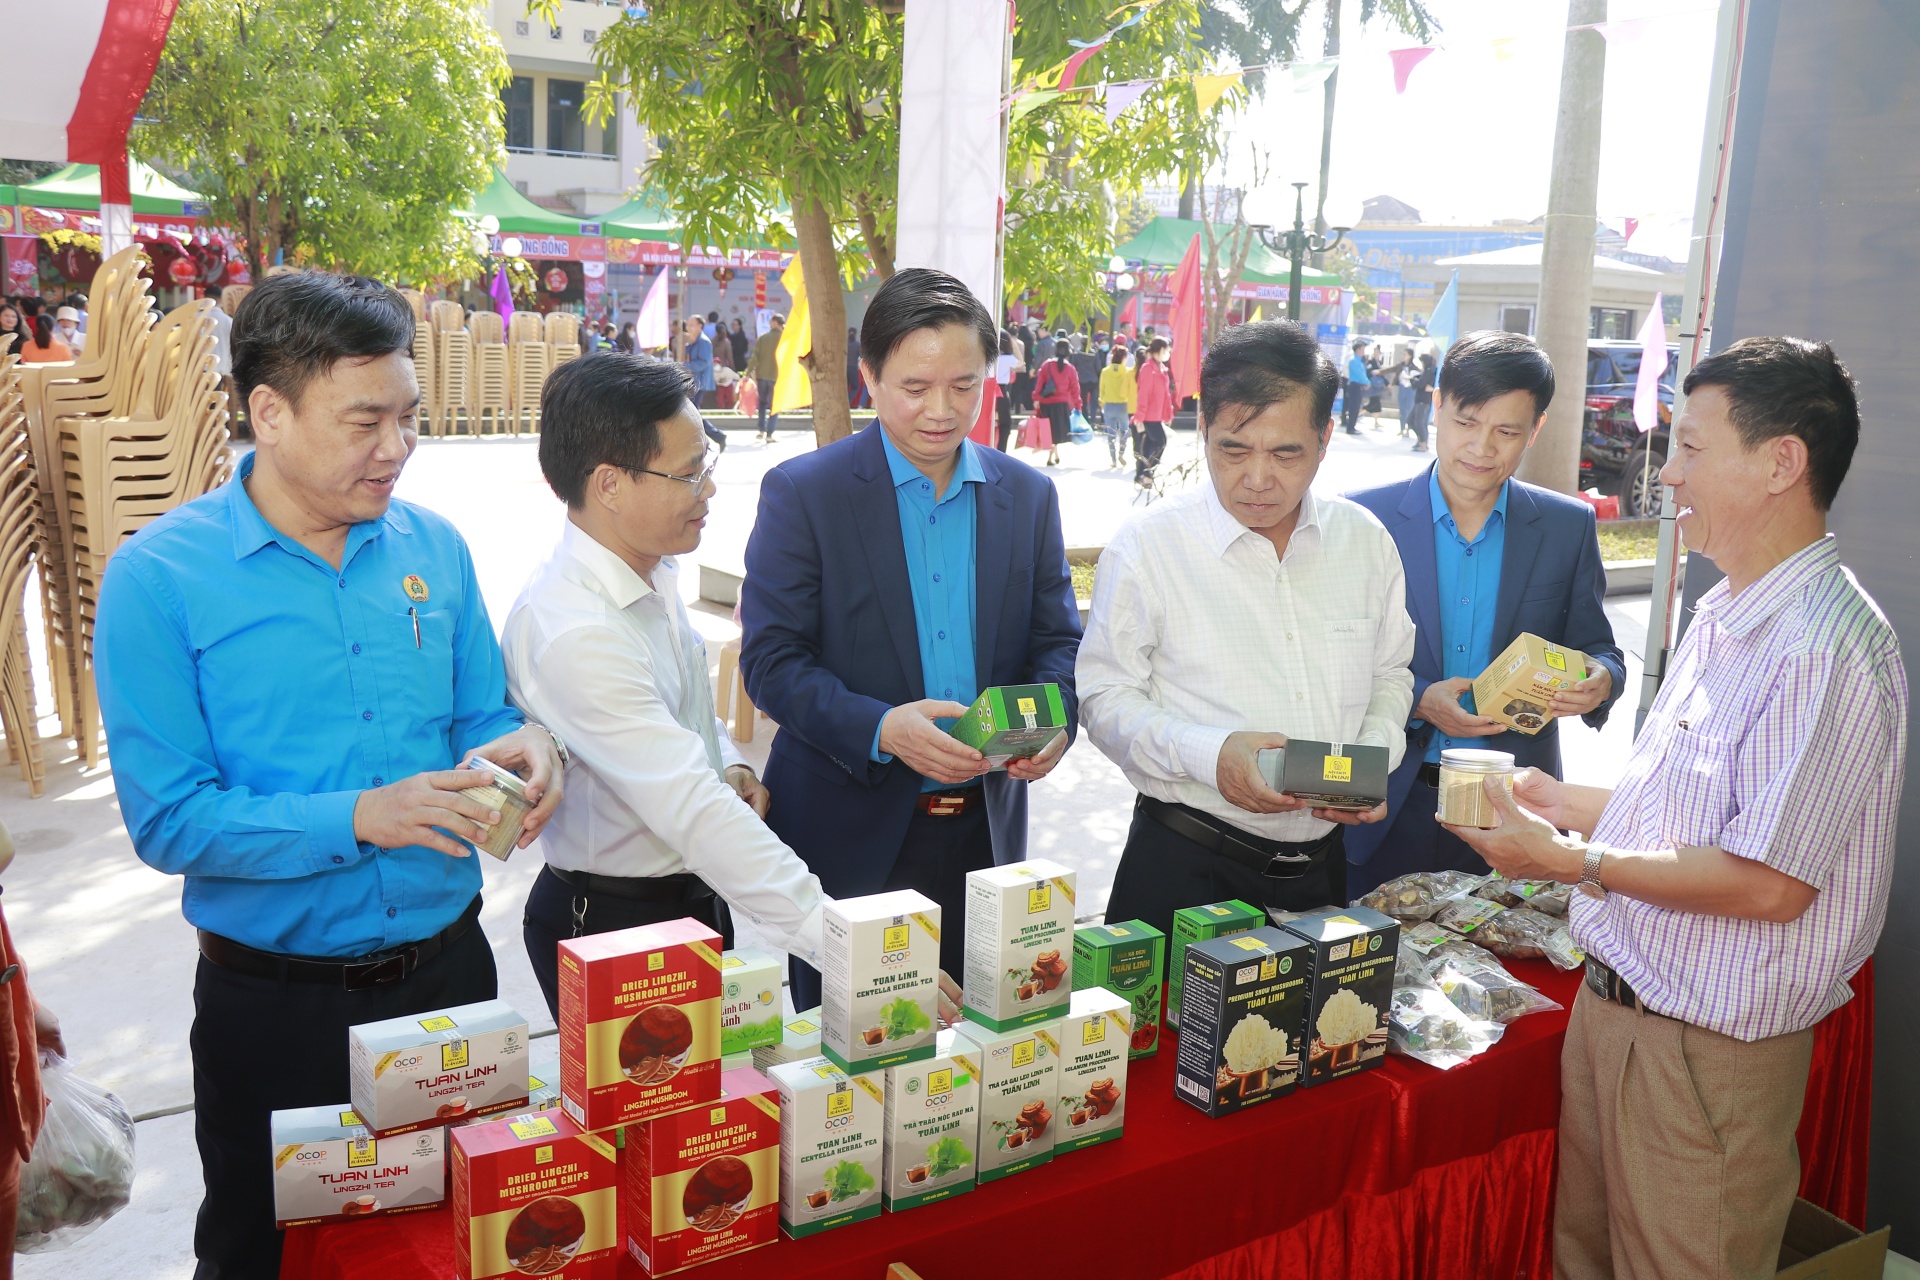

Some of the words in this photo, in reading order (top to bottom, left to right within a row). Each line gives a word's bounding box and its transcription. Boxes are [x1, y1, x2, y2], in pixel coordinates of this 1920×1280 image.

[541, 235, 569, 256] ĐỒNG
[1020, 923, 1039, 935] TUAN
[1040, 920, 1057, 932] LINH
[882, 952, 910, 964] OCOP
[1133, 960, 1150, 970] LINH
[1361, 956, 1394, 968] MUSHROOMS
[872, 974, 896, 986] TUAN
[898, 970, 918, 982] LINH
[1239, 966, 1256, 976] OCOP
[1339, 973, 1356, 984] TUAN
[1358, 968, 1374, 980] LINH
[622, 980, 648, 993] DRIED
[652, 971, 686, 986] LINGZHI
[856, 986, 891, 998] CENTELLA
[893, 982, 918, 992] HERBAL
[920, 978, 933, 986] TEA
[614, 986, 668, 1005] MUSHROOM
[671, 980, 697, 993] CHIPS
[1228, 991, 1254, 1004] PREMIUM
[1271, 978, 1304, 992] MUSHROOMS
[739, 1002, 750, 1012] Chi
[1247, 998, 1266, 1010] TUAN
[1268, 992, 1285, 1004] LINH
[722, 1015, 740, 1028] Linh
[394, 1056, 422, 1068] OCOP
[1075, 1053, 1094, 1063] TUAN
[1095, 1050, 1111, 1059] LINH
[1064, 1062, 1088, 1072] SOLANUM
[415, 1072, 460, 1090] TUAN
[466, 1064, 497, 1080] LINH
[1023, 1078, 1040, 1090] LINH
[428, 1085, 462, 1098] LINGZHI
[466, 1080, 485, 1090] TEA
[640, 1088, 656, 1098] TUAN
[658, 1084, 672, 1096] LINH
[988, 1081, 1000, 1090] TRÀ
[624, 1098, 650, 1112] LINGZHI
[650, 1090, 688, 1106] MUSHROOM
[926, 1094, 954, 1108] OCOP
[825, 1115, 854, 1129] OCOP
[904, 1121, 917, 1130] TRÀ
[942, 1120, 960, 1132] LINH
[686, 1133, 712, 1146] DRIED
[714, 1124, 747, 1138] LINGZHI
[817, 1139, 841, 1150] TUAN
[842, 1132, 862, 1144] LINH
[679, 1140, 729, 1158] MUSHROOM
[732, 1131, 757, 1144] CHIPS
[801, 1150, 835, 1163] CENTELLA
[837, 1143, 862, 1154] HERBAL
[864, 1138, 877, 1147] TEA
[296, 1151, 326, 1160] OCOP
[318, 1170, 368, 1184] TUAN
[374, 1165, 408, 1179] LINH
[508, 1172, 536, 1186] DRIED
[540, 1163, 578, 1178] LINGZHI
[334, 1184, 370, 1194] LINGZHI
[500, 1178, 557, 1198] MUSHROOM
[561, 1172, 589, 1184] CHIPS
[703, 1233, 718, 1244] TUAN
[720, 1230, 733, 1240] LINH
[687, 1243, 712, 1256] LINGZHI
[712, 1234, 748, 1250] MUSHROOM
